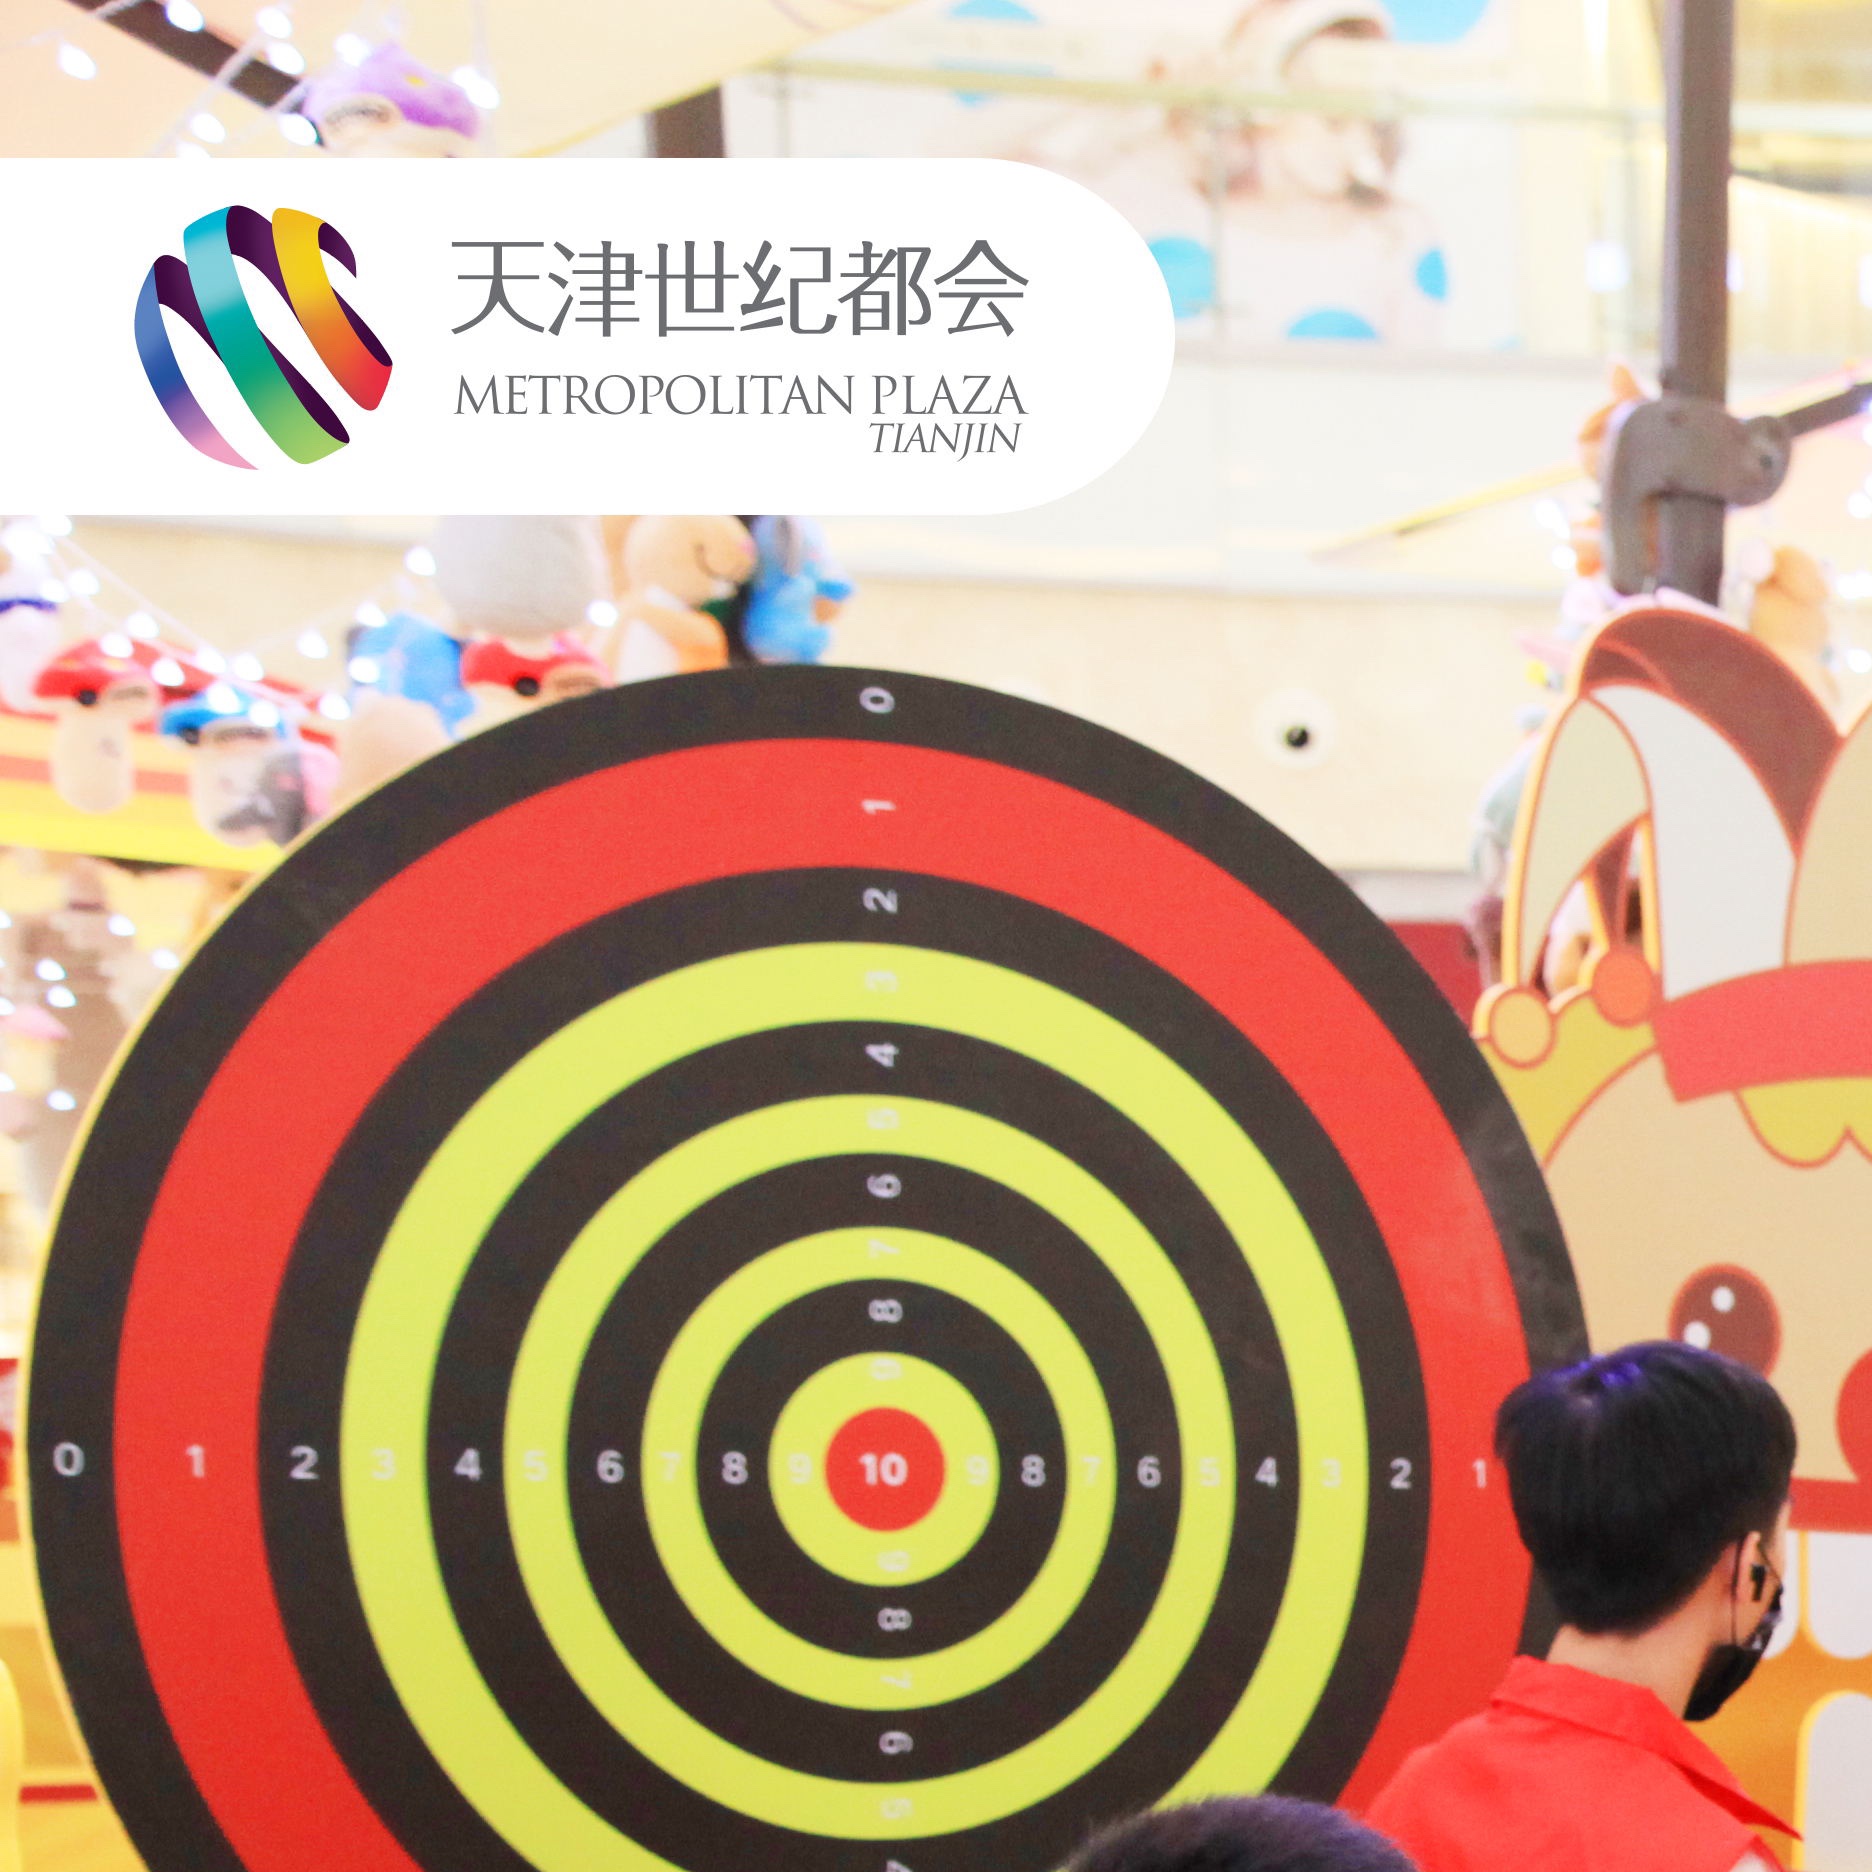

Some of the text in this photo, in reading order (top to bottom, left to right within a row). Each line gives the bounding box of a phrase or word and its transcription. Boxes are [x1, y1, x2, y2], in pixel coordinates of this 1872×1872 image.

[859, 686, 895, 714] 0
[861, 799, 895, 814] 1
[862, 887, 898, 913] 2
[865, 1043, 898, 1067] 4
[866, 1173, 901, 1199] 6
[867, 1238, 900, 1258] 7
[868, 1298, 903, 1323] 8
[53, 1441, 1487, 1490] 0 1 2 3 4 5 6 7 8 9 10 9 8 7 6 5 4 3 2 1
[877, 1607, 912, 1632] 8
[880, 1671, 913, 1690] 7
[879, 1730, 913, 1755] 6
